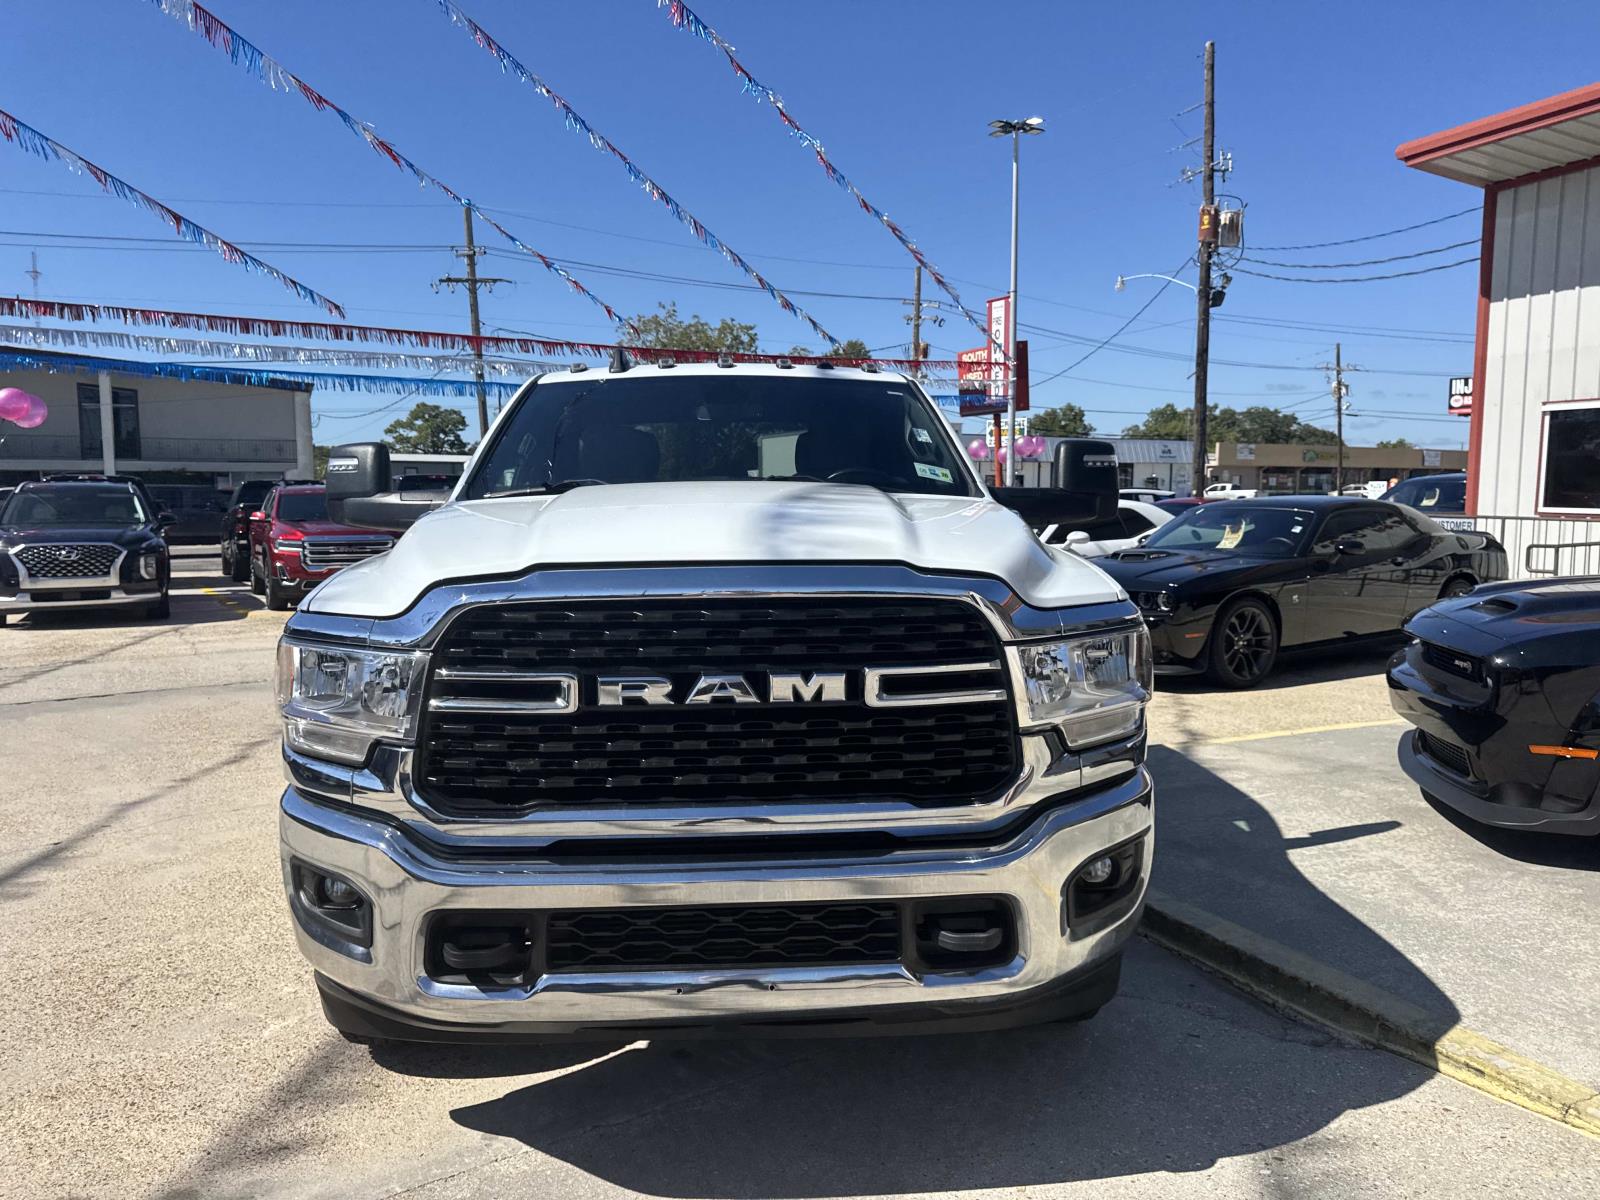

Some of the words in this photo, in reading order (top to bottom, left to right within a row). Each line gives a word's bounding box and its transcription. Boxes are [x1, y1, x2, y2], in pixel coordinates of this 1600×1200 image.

[961, 350, 988, 362] SOUTH
[1452, 379, 1472, 394] INJ
[1436, 520, 1473, 531] STOMER
[597, 672, 846, 706] RAM
